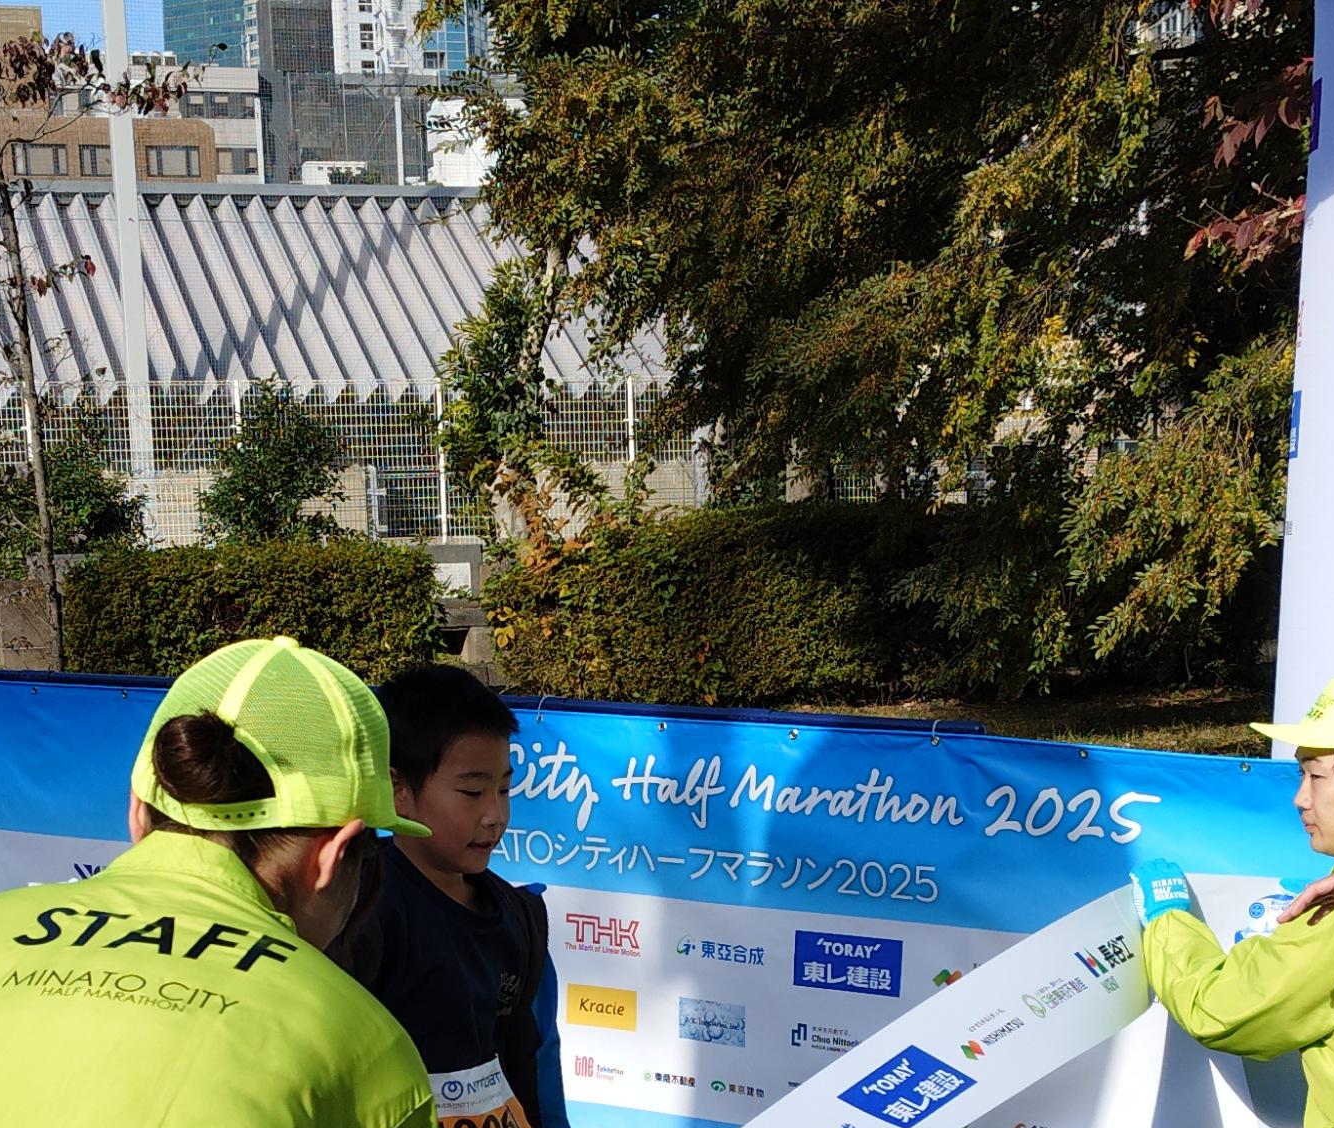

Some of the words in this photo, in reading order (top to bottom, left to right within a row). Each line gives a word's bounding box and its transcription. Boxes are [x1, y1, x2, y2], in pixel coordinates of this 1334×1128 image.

[612, 754, 726, 829] Half
[729, 764, 963, 827] Marathon
[984, 784, 1162, 844] 2025
[492, 827, 939, 903] ATOシティハーフマラソン2025
[13, 907, 297, 972] STAFF
[566, 913, 640, 949] THK
[701, 941, 764, 965] 東亞合成
[1098, 935, 1134, 968] 長谷工
[2, 969, 146, 993] MINATO
[158, 981, 239, 1014] CITY
[802, 961, 891, 991] 東レ建設
[41, 985, 81, 998] HALF
[84, 988, 187, 1013] MARATHON
[579, 998, 625, 1015] Kracie
[812, 1035, 831, 1044] Chuo
[832, 1037, 860, 1048] Nittoch
[981, 1017, 1025, 1046] NISHIMATSU
[728, 1084, 765, 1098] 東京建物
[882, 1069, 965, 1123] 東レ建設
